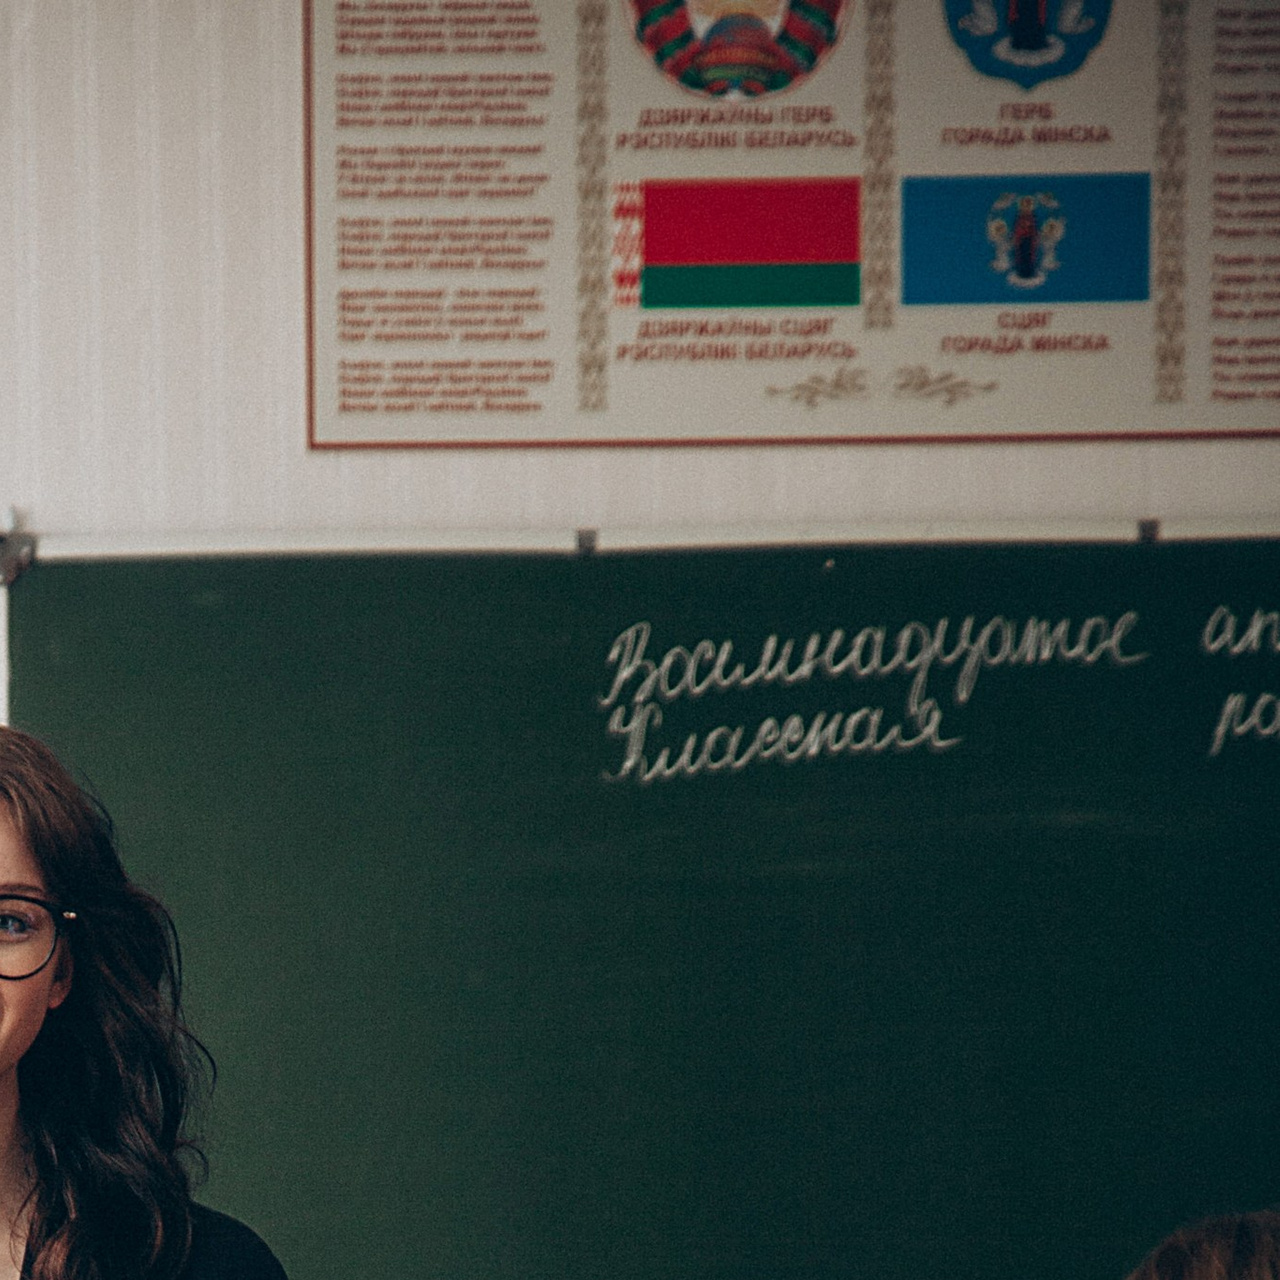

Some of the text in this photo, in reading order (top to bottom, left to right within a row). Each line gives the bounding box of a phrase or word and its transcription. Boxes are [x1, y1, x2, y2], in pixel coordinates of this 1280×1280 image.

[1000, 102, 1052, 120] ГЕРБ
[942, 127, 1025, 147] ГОРАДА
[941, 335, 1023, 354] ГОРАДА
[601, 699, 963, 783] Классная
